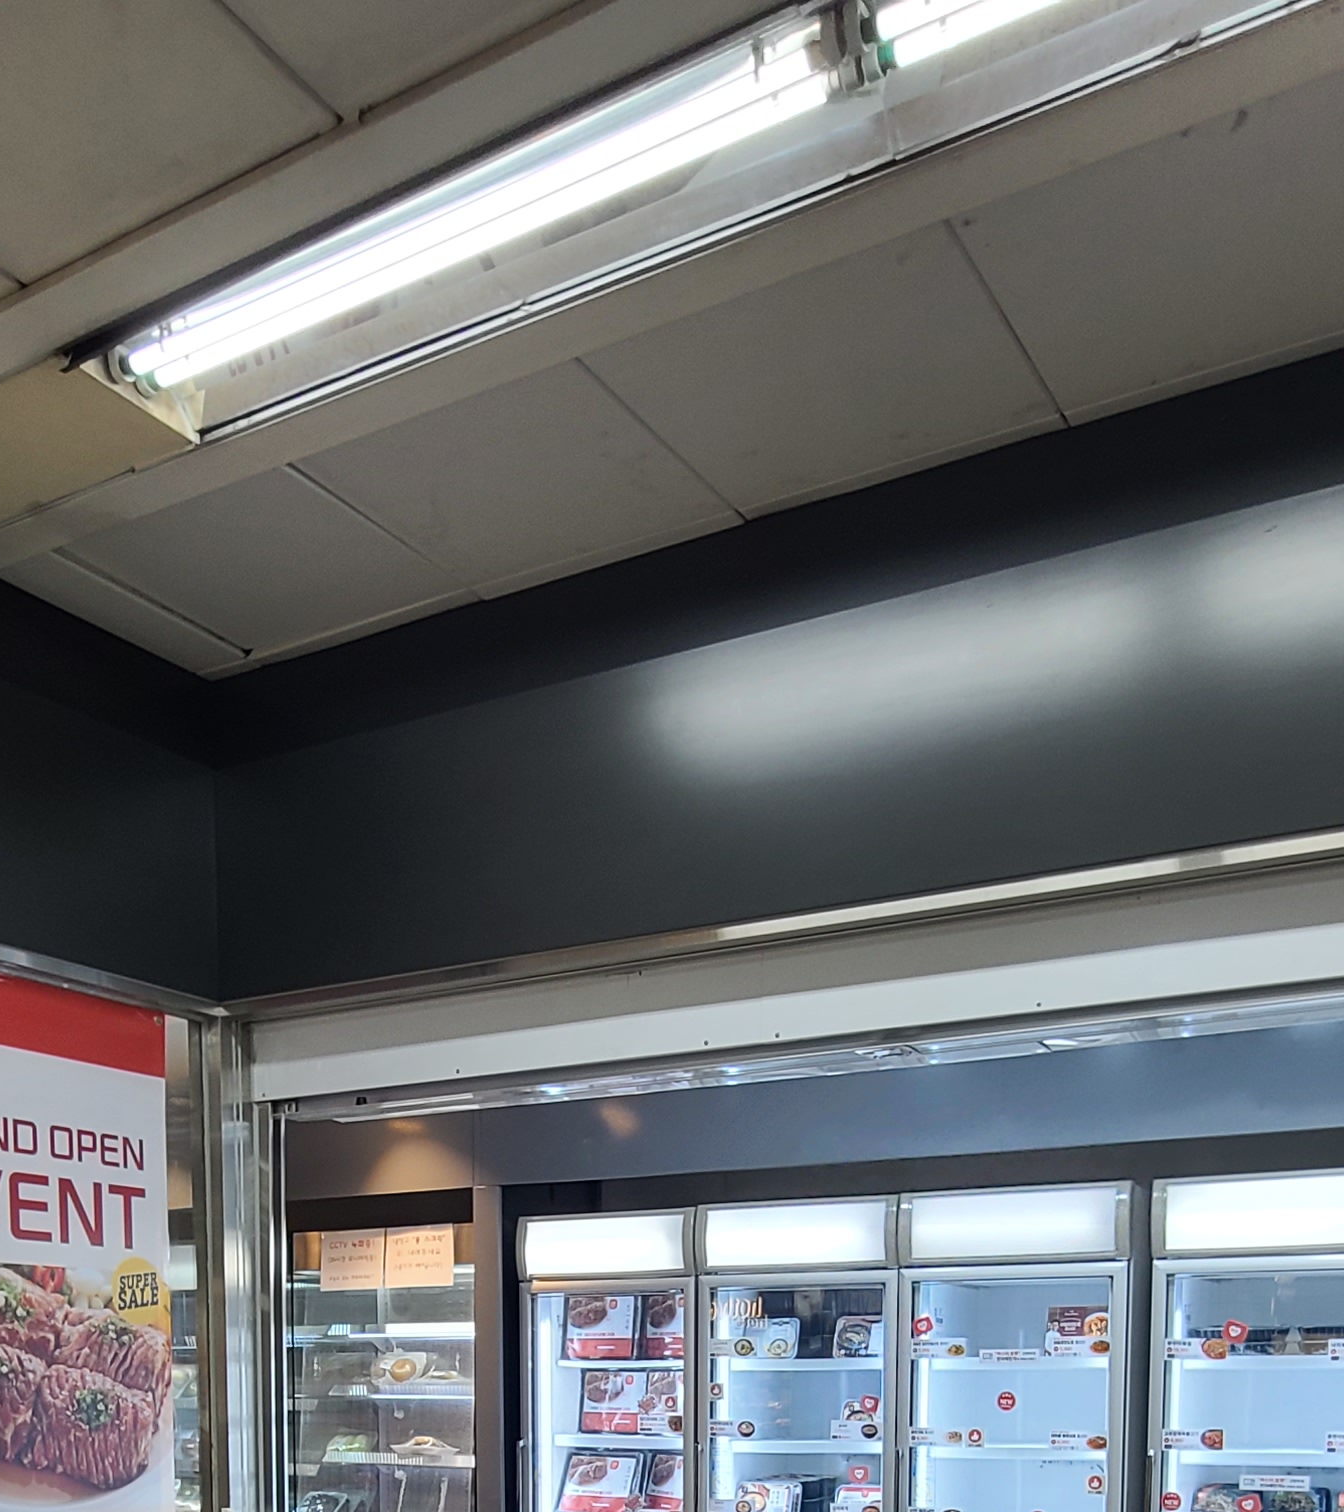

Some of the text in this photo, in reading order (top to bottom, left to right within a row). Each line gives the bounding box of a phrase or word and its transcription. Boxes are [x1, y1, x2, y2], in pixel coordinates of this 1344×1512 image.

[50, 1125, 145, 1171] OPEN
[119, 1271, 158, 1296] SUPER
[118, 1288, 159, 1311] SALE
